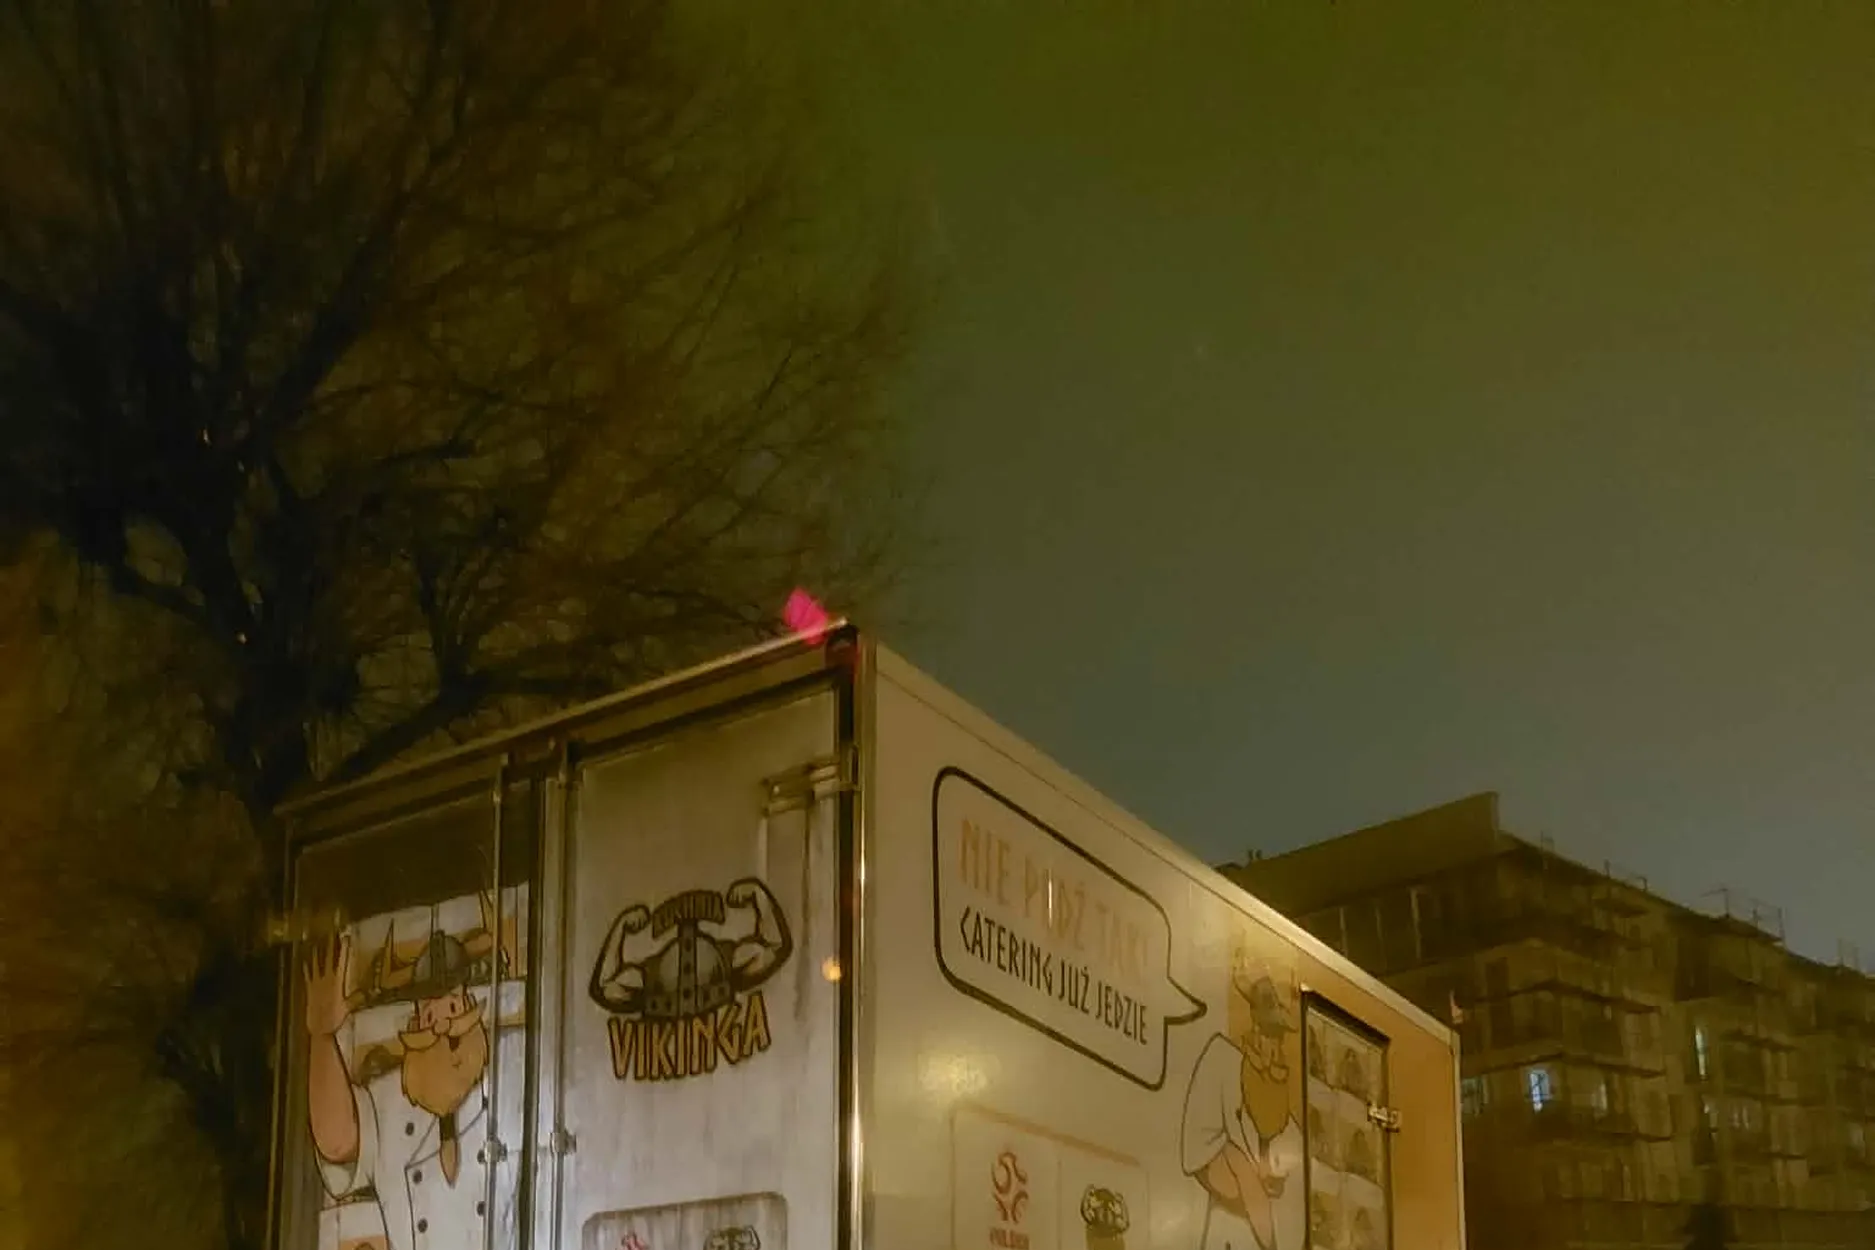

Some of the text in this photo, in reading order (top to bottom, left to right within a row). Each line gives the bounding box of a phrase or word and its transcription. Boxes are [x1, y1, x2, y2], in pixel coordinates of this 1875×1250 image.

[960, 905, 1148, 1045] CATERING JUŻ JEDZIE
[607, 990, 772, 1082] VIKINGA
